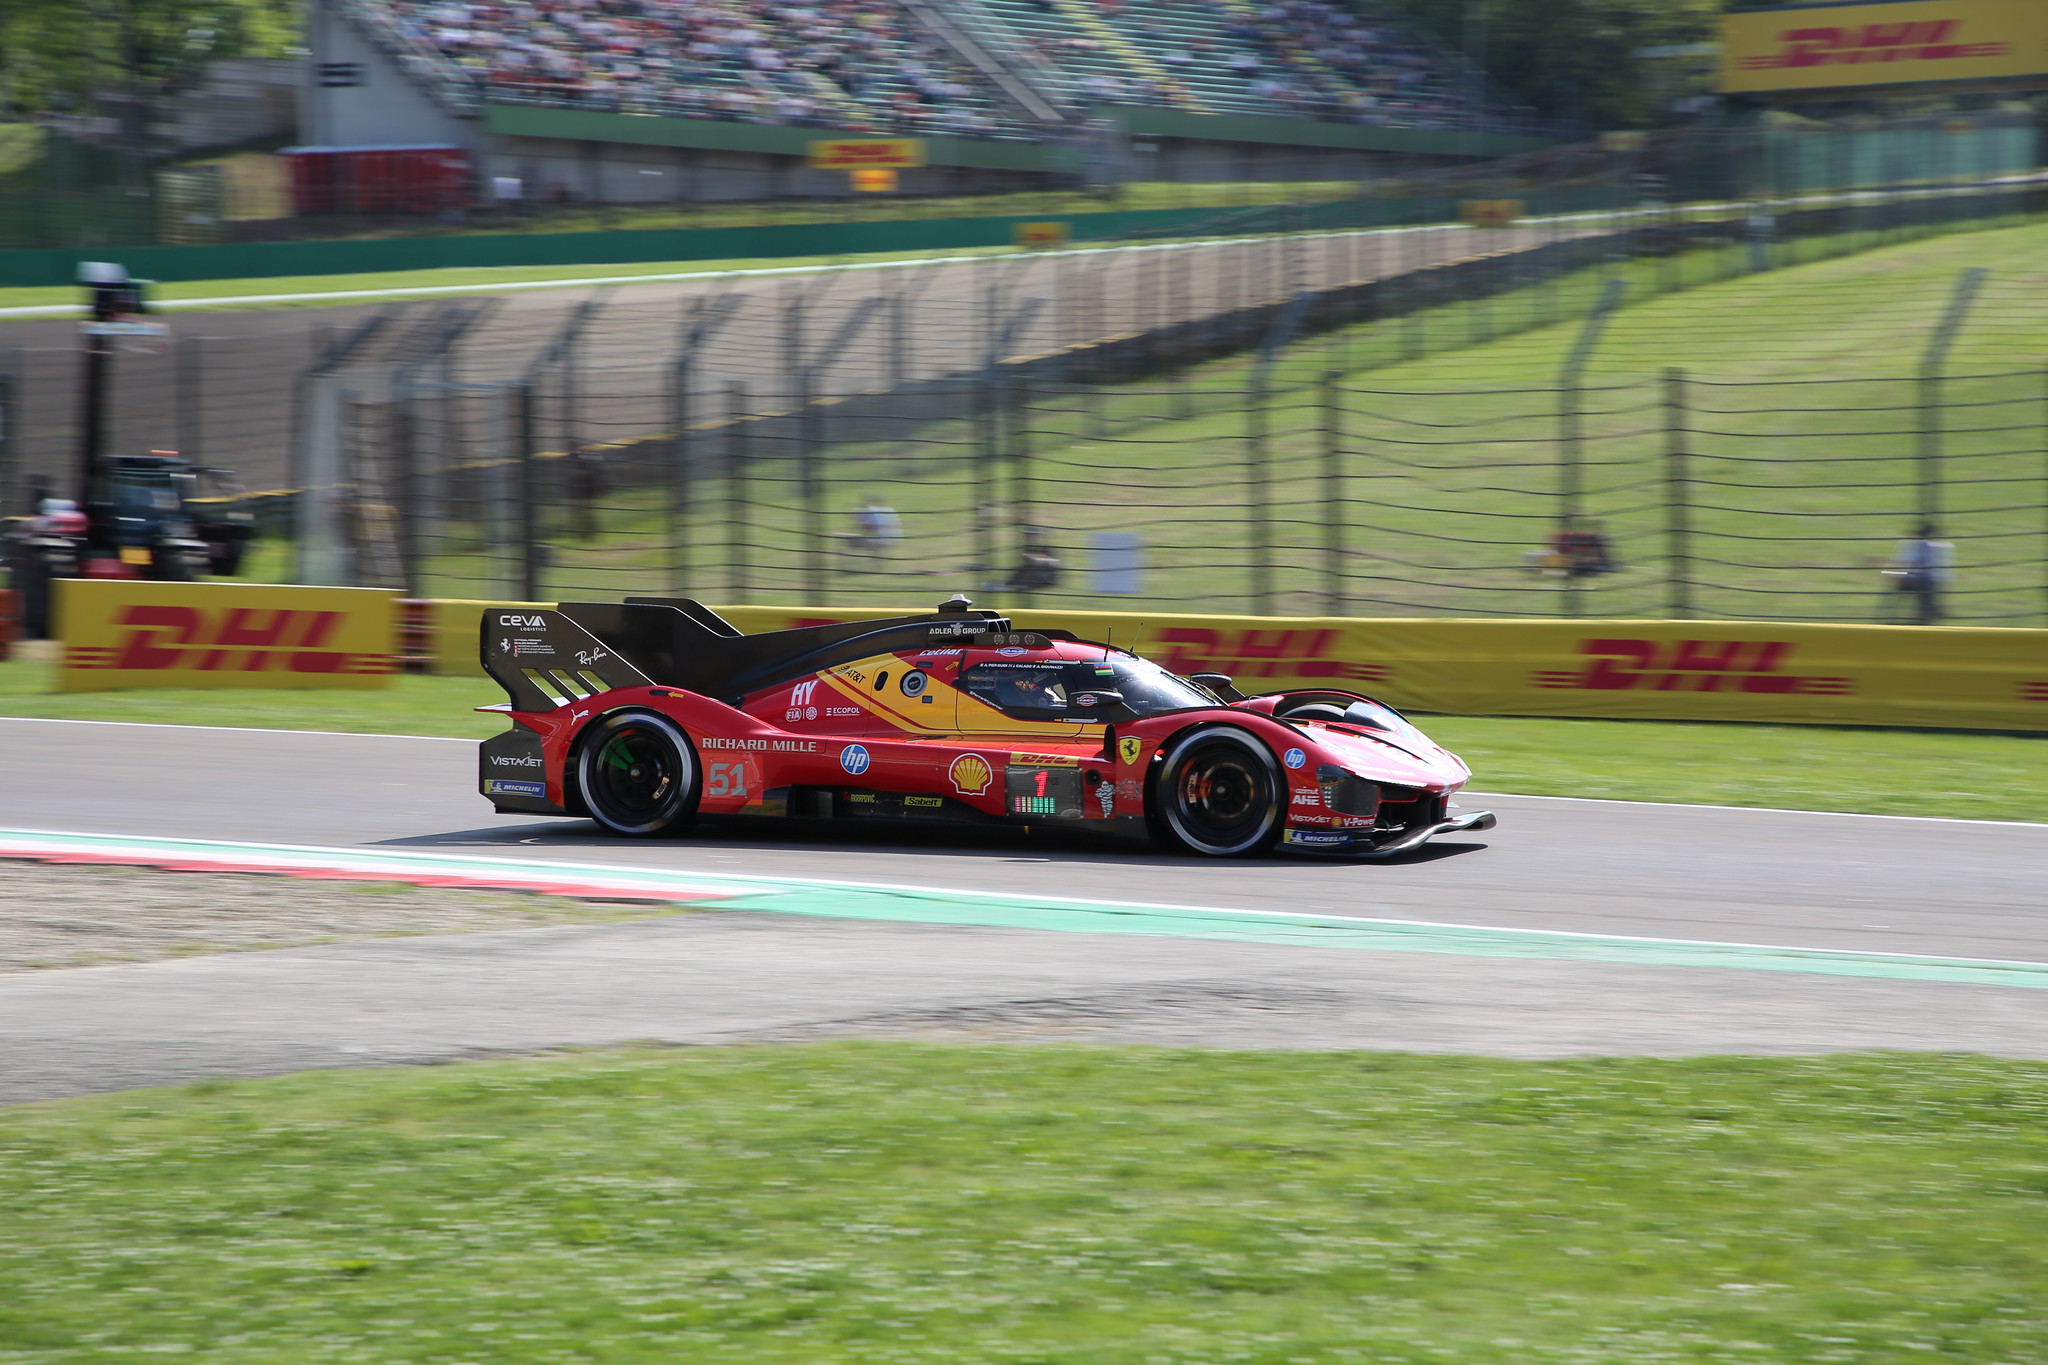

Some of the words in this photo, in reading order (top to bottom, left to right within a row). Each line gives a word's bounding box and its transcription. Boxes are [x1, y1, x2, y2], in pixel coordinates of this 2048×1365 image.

[1774, 19, 1964, 68] DHL
[110, 604, 349, 674] DHL
[929, 627, 952, 635] ADLER
[962, 627, 986, 635] GROUP
[575, 647, 607, 665] Ray-Ban
[1570, 638, 1798, 694] DHL
[846, 668, 867, 684] AT&T
[791, 679, 819, 706] HY
[786, 710, 801, 721] FIA
[702, 737, 767, 750] RICHARD
[772, 740, 817, 752] MILLE
[844, 745, 867, 774] hp
[1018, 753, 1072, 764] DHL
[1287, 748, 1304, 768] hp
[503, 784, 541, 792] MICHELIN
[709, 762, 748, 796] 51
[1034, 770, 1049, 797] 1
[907, 797, 938, 806] Sabelt
[1292, 794, 1321, 806] AHE
